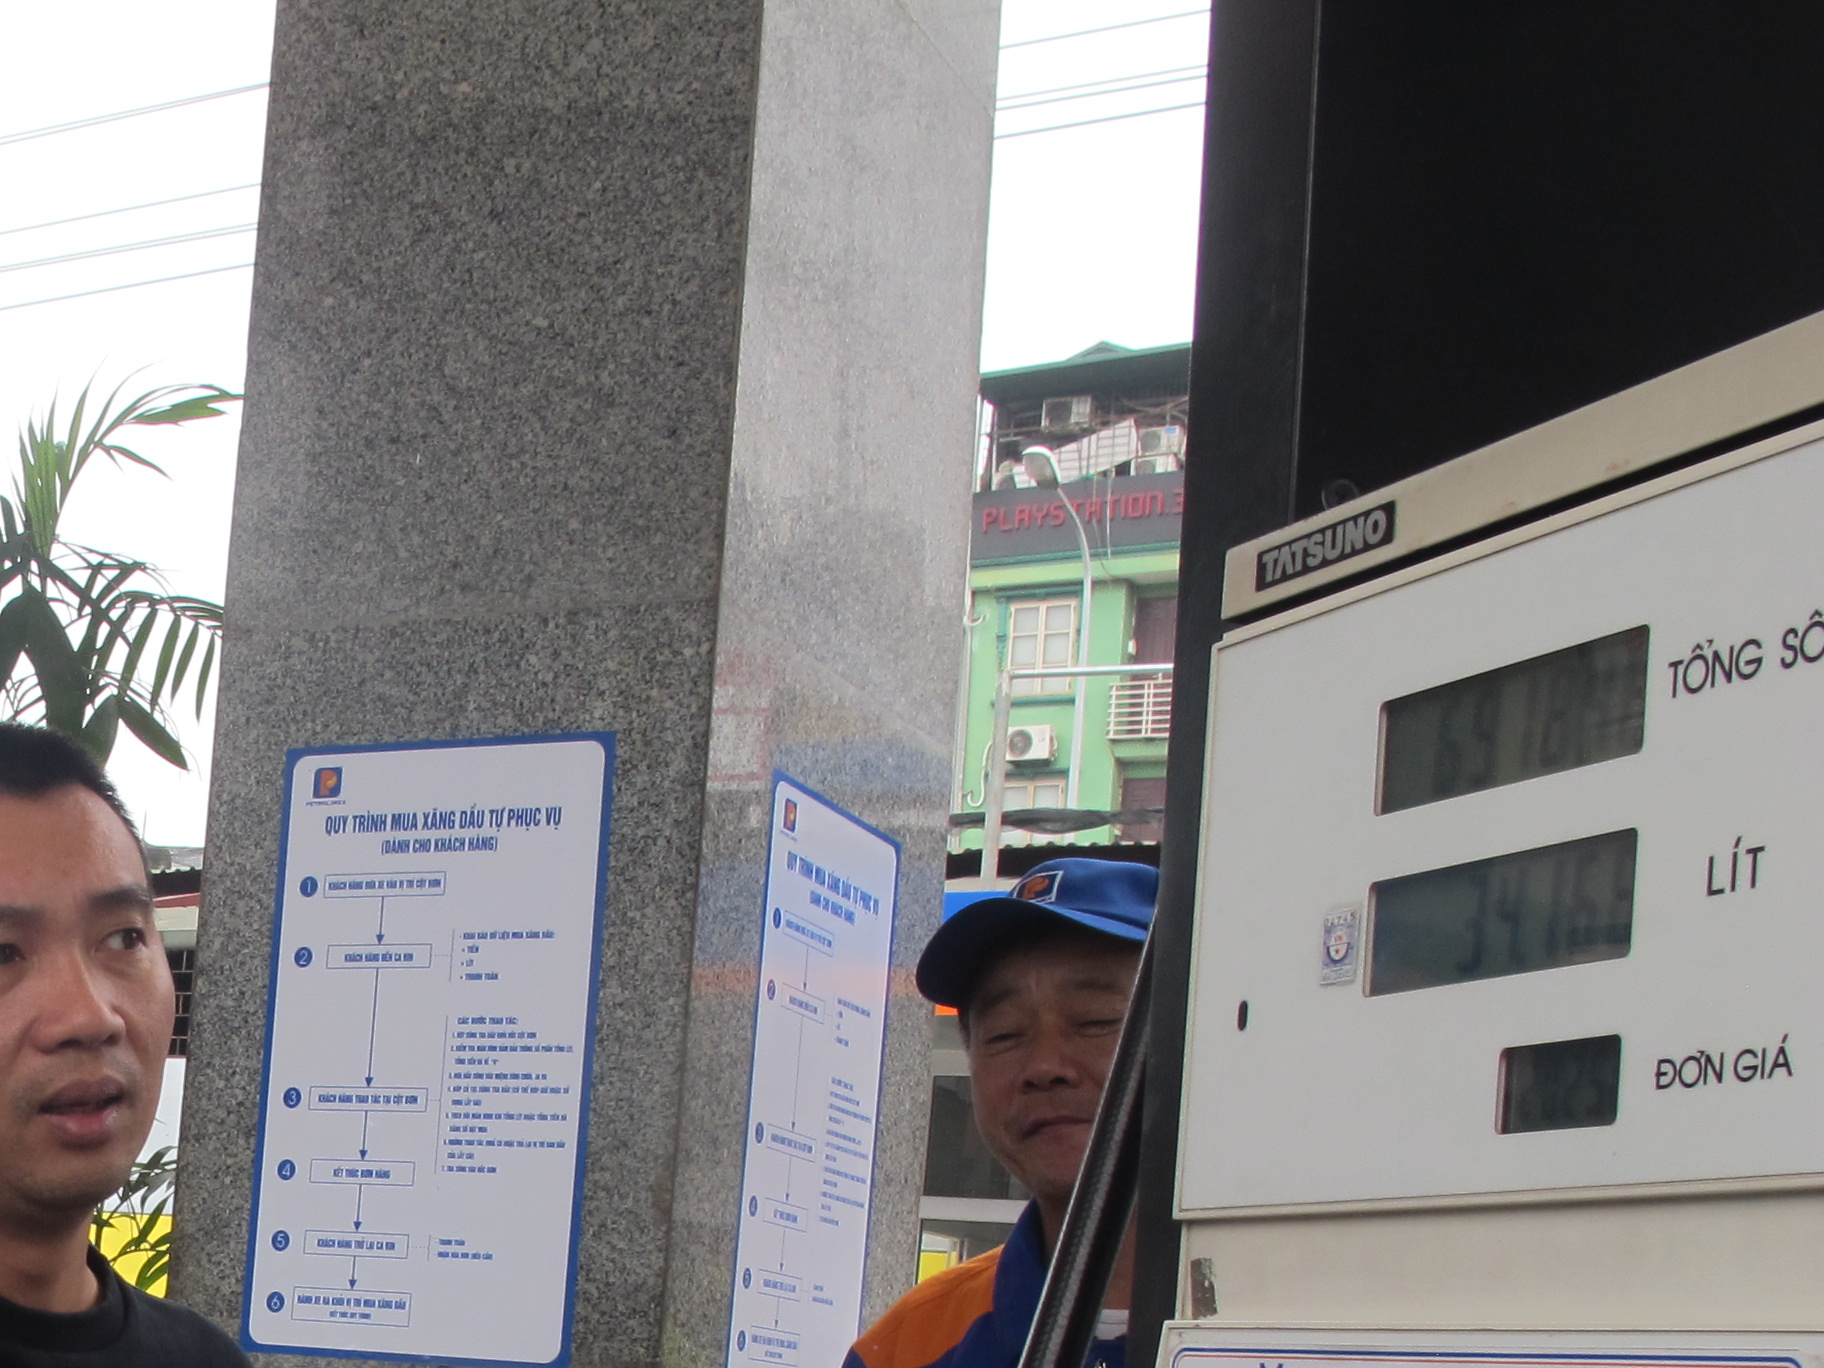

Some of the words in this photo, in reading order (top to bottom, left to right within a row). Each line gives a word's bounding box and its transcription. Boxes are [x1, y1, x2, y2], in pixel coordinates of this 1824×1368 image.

[1262, 510, 1387, 583] TATSUNO
[1668, 638, 1764, 699] TỔNG
[325, 814, 348, 836] QUY
[352, 809, 387, 833] TRÌNH
[390, 811, 418, 832] MUA
[421, 805, 456, 831] XĂNG
[459, 802, 485, 830] DẦU
[487, 806, 505, 832] TỰ
[506, 806, 542, 831] PHỤC
[544, 805, 562, 831] VỤ
[381, 836, 410, 855] (DÀNH
[412, 838, 431, 853] CHO
[433, 835, 465, 852] KHÁCH
[467, 834, 498, 852] HÀNG)
[1705, 836, 1766, 897] LÍT
[1654, 1049, 1725, 1091] ĐƠN
[1733, 1034, 1794, 1085] GIÁ
